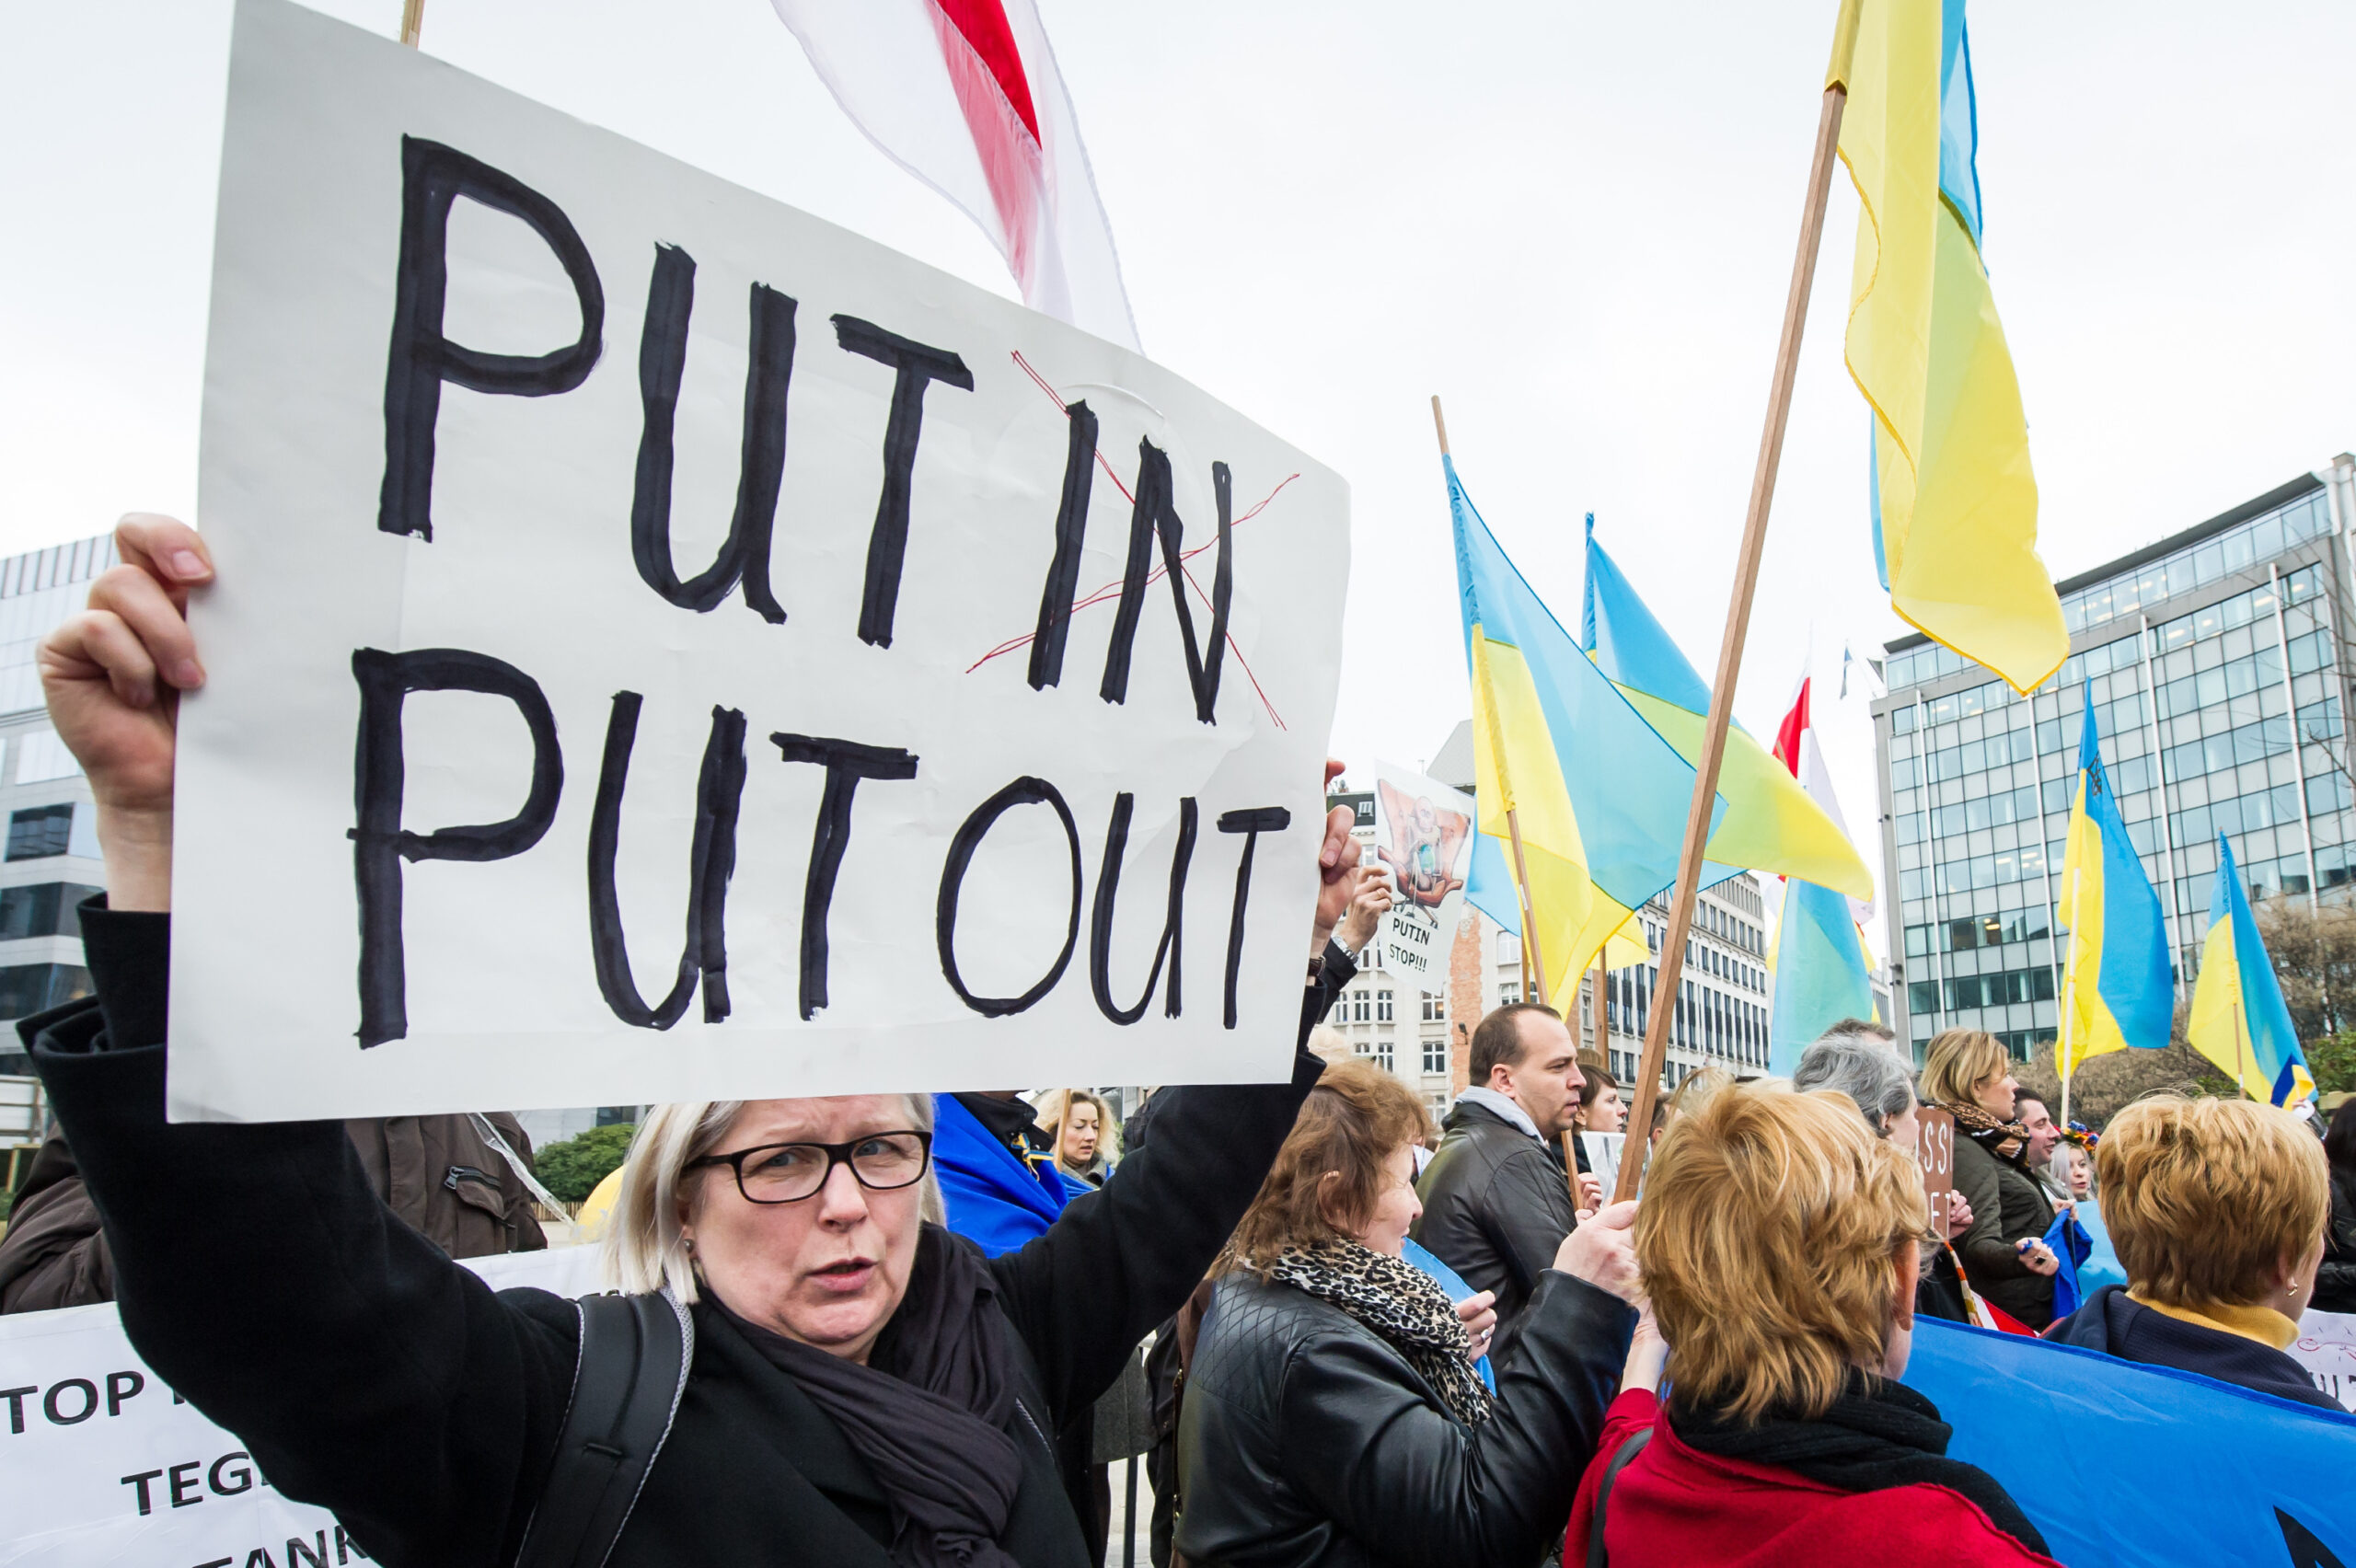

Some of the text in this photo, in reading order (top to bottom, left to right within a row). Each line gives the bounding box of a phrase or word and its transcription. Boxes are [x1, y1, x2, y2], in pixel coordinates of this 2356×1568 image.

[1392, 917, 1430, 945] PUTIN
[1389, 943, 1427, 972] STOP!!!
[121, 1451, 270, 1516] TEG
